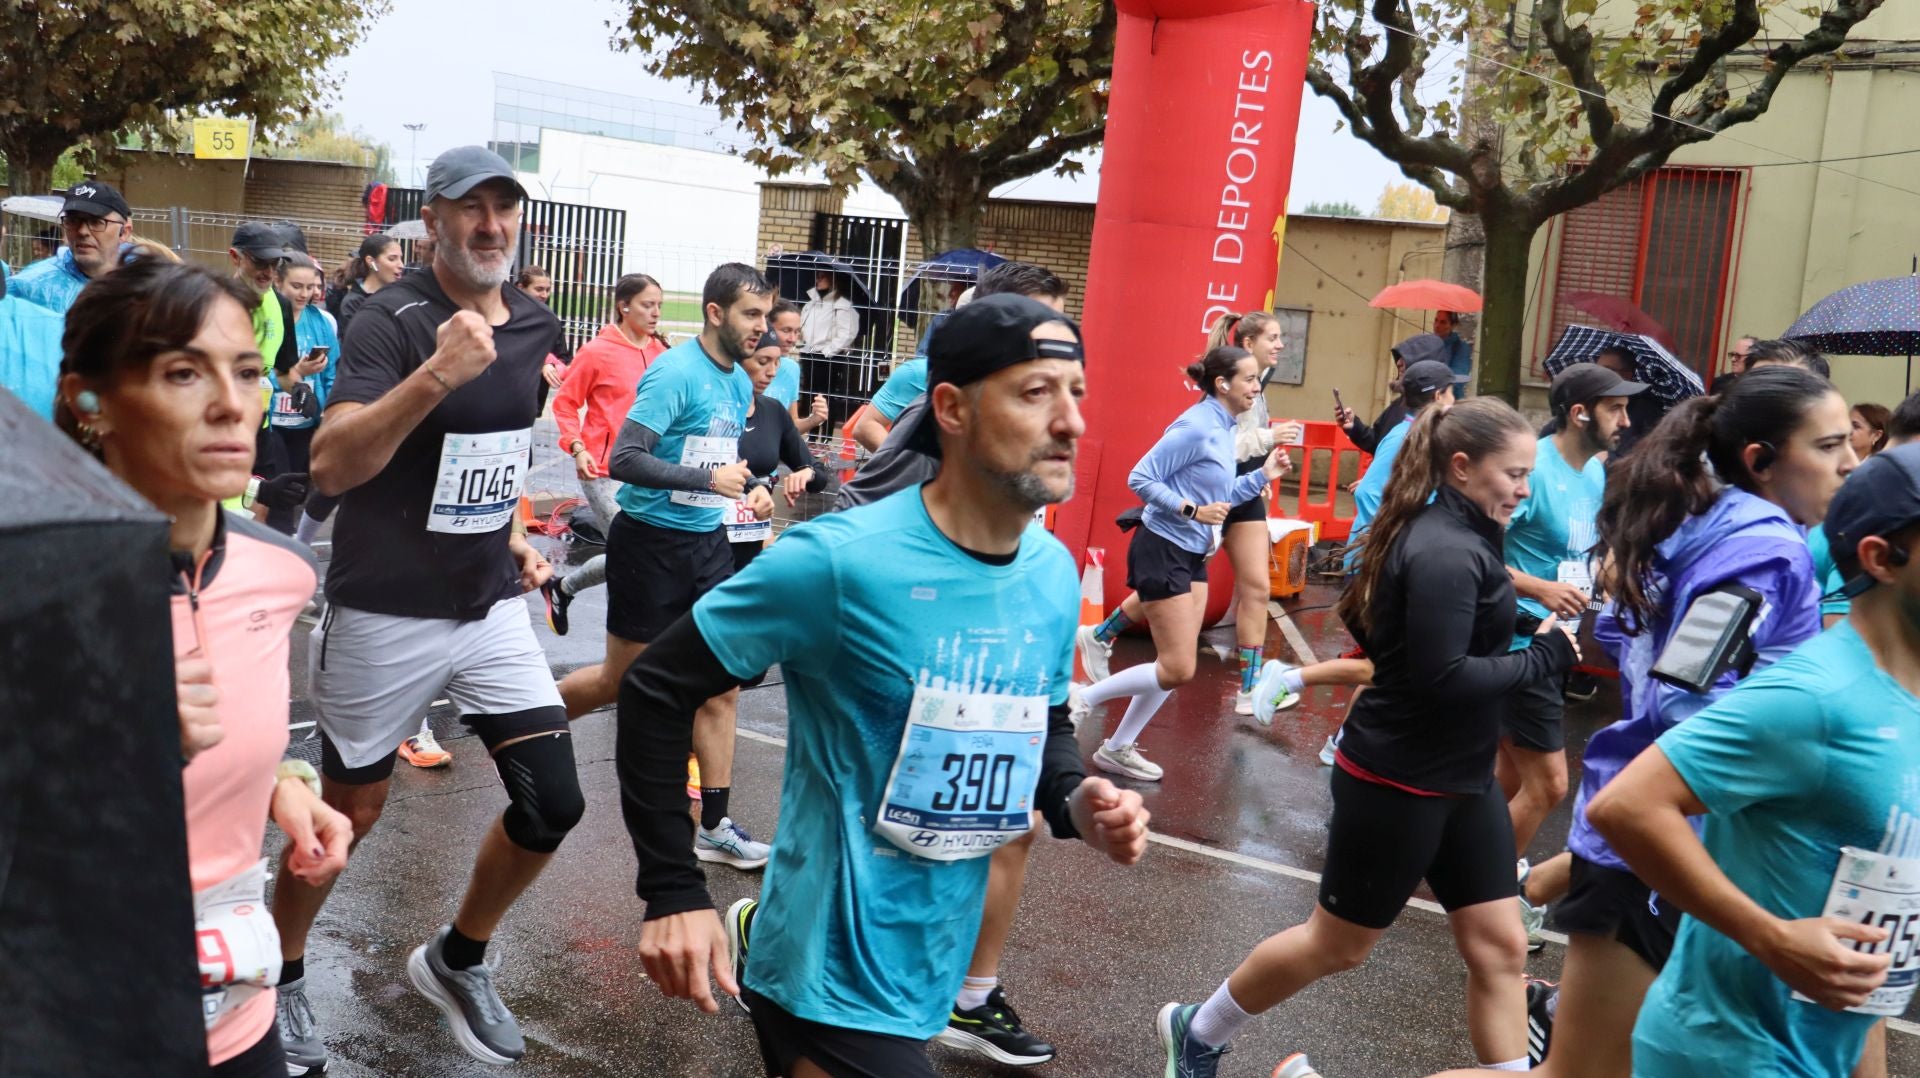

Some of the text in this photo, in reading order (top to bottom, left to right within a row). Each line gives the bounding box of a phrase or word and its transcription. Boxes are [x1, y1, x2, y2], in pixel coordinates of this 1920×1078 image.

[213, 131, 235, 151] 55
[1202, 49, 1273, 334] DE DEPORTES
[457, 464, 515, 504] 1046
[931, 753, 1016, 811] 390
[1854, 911, 1920, 968] 105
